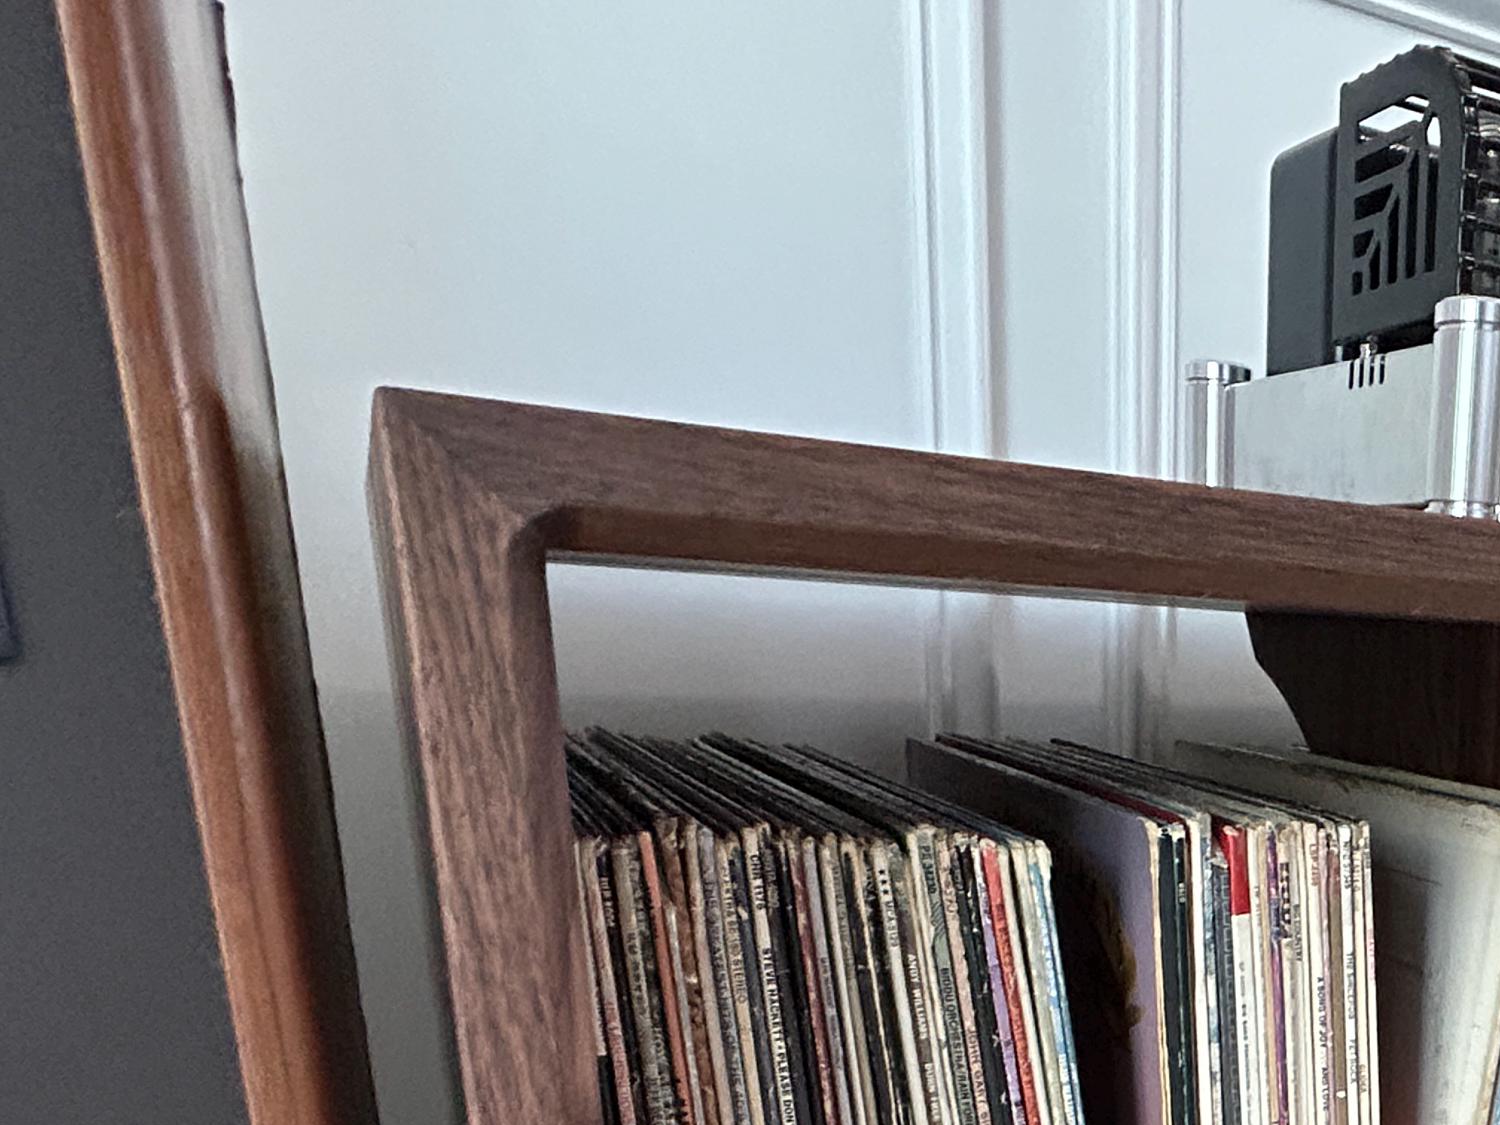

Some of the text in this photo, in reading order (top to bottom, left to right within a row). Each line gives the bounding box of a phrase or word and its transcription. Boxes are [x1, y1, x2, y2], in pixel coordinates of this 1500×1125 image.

[1293, 919, 1303, 962] COUNTRY
[760, 947, 775, 985] STEVE
[906, 953, 920, 983] ANDY
[939, 967, 954, 1003] BIDDU
[1316, 985, 1325, 1012] SONG
[766, 988, 783, 1043] HACKETT
[911, 988, 928, 1040] WILLIAMS
[1318, 1015, 1326, 1028] OF
[1318, 1029, 1327, 1049] JOY
[775, 1053, 791, 1095] PLEASE
[1321, 1087, 1329, 1112] LOVE
